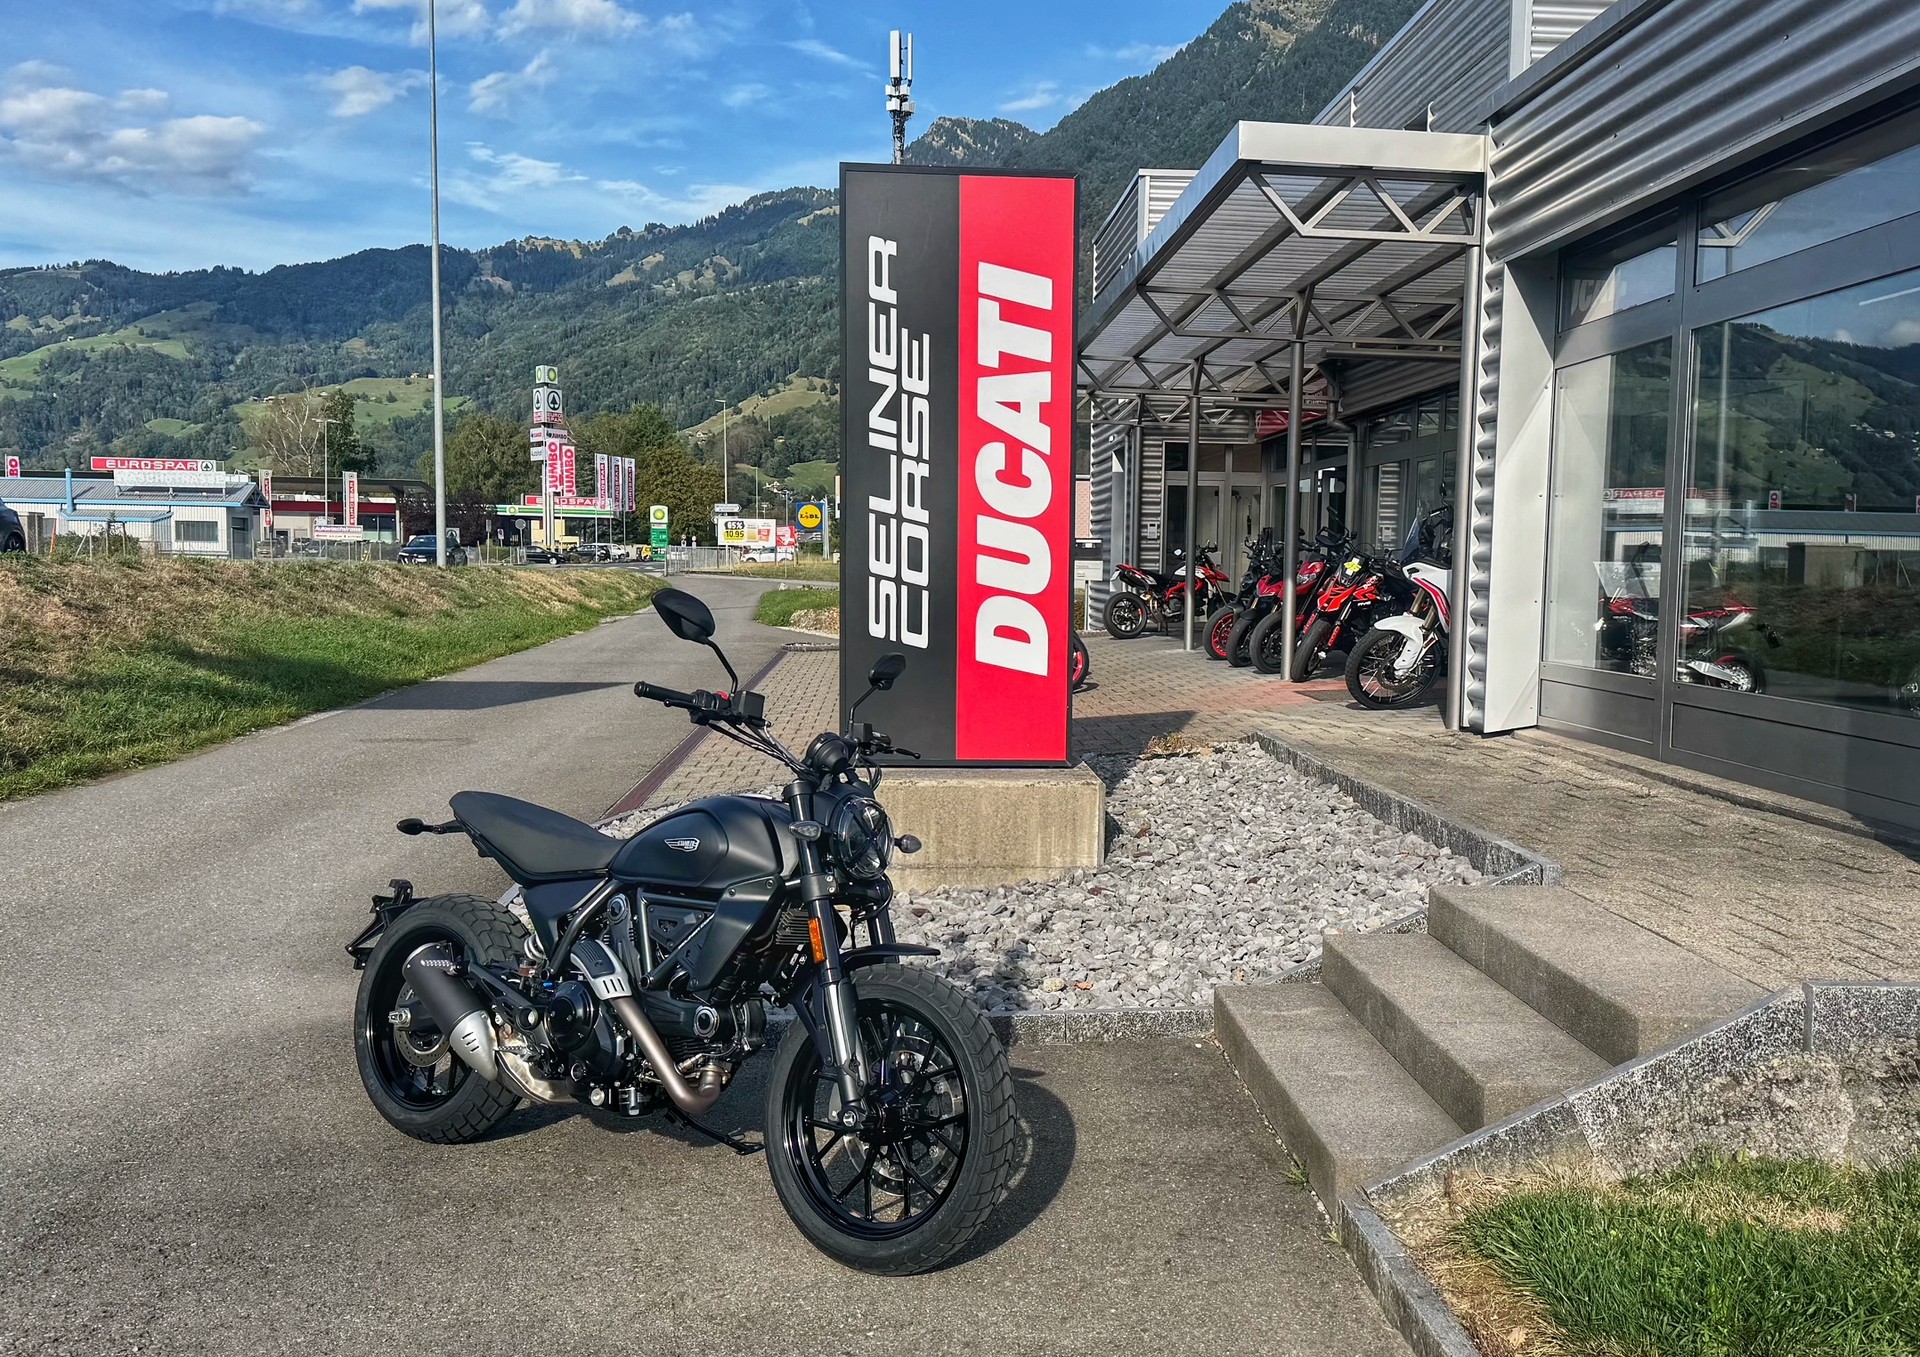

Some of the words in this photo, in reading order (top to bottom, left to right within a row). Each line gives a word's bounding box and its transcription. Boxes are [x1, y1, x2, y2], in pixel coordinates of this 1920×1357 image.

[868, 235, 898, 642] SELINER
[106, 459, 198, 470] EUROSPAR
[548, 441, 558, 490] JUMBO
[564, 448, 575, 495] JUMBO
[901, 327, 930, 650] CORSE
[975, 261, 1054, 677] DUCATI
[725, 530, 744, 538] 10.95
